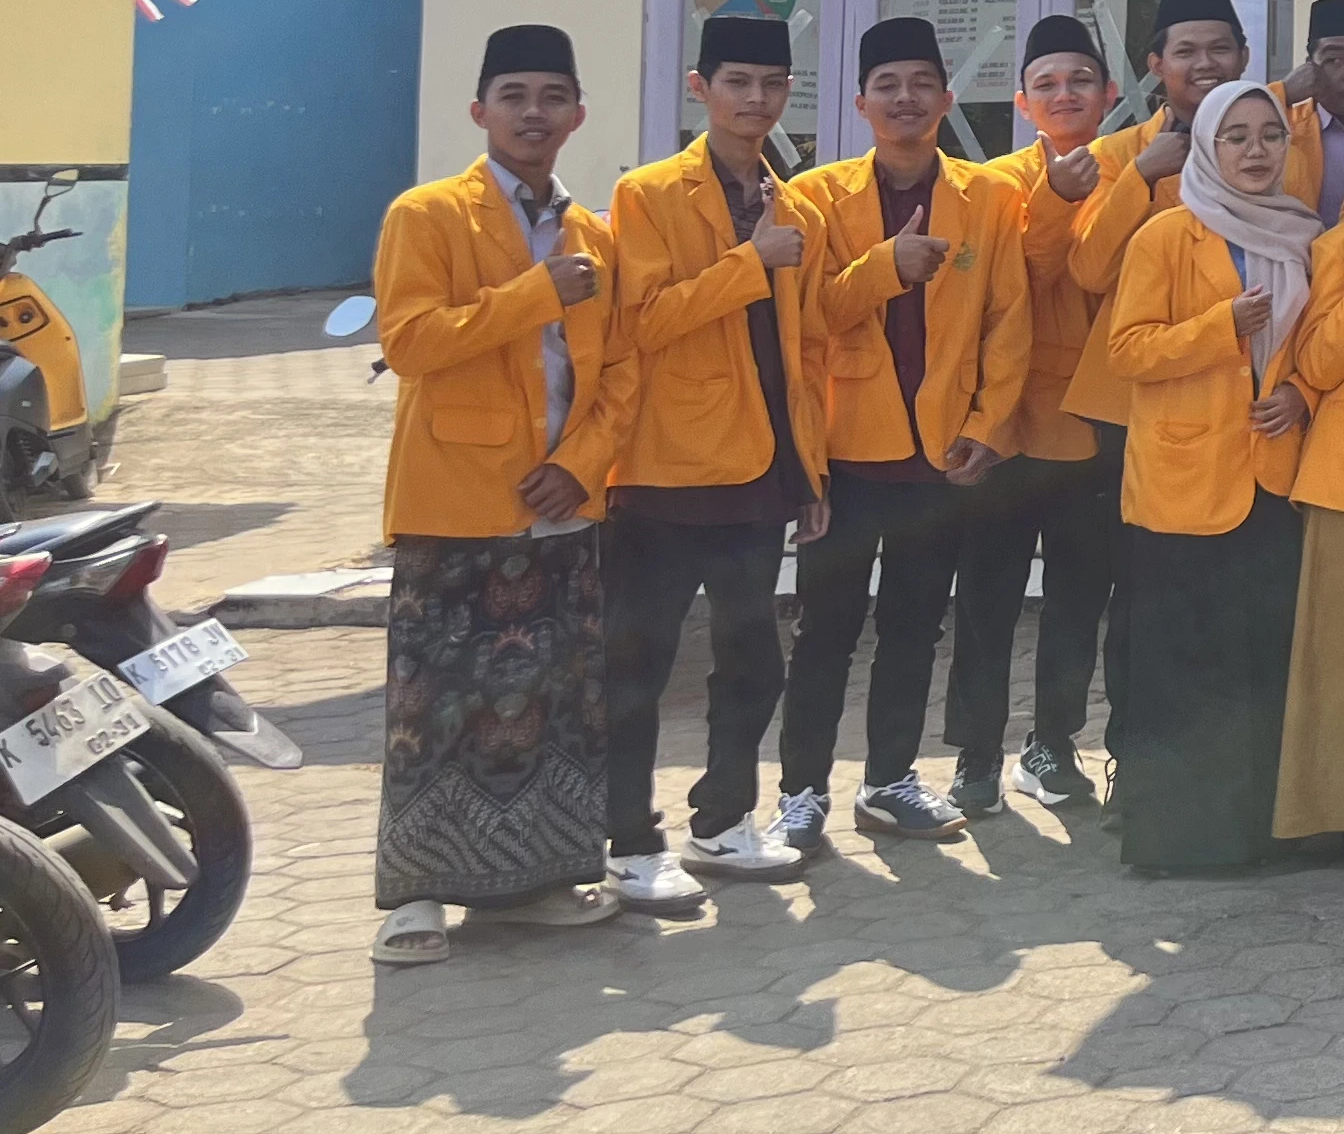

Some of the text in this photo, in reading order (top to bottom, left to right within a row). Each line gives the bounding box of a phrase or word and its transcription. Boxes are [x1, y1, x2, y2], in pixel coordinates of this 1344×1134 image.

[126, 663, 148, 684] K
[0, 739, 21, 769] K
[26, 698, 85, 746] 5463
